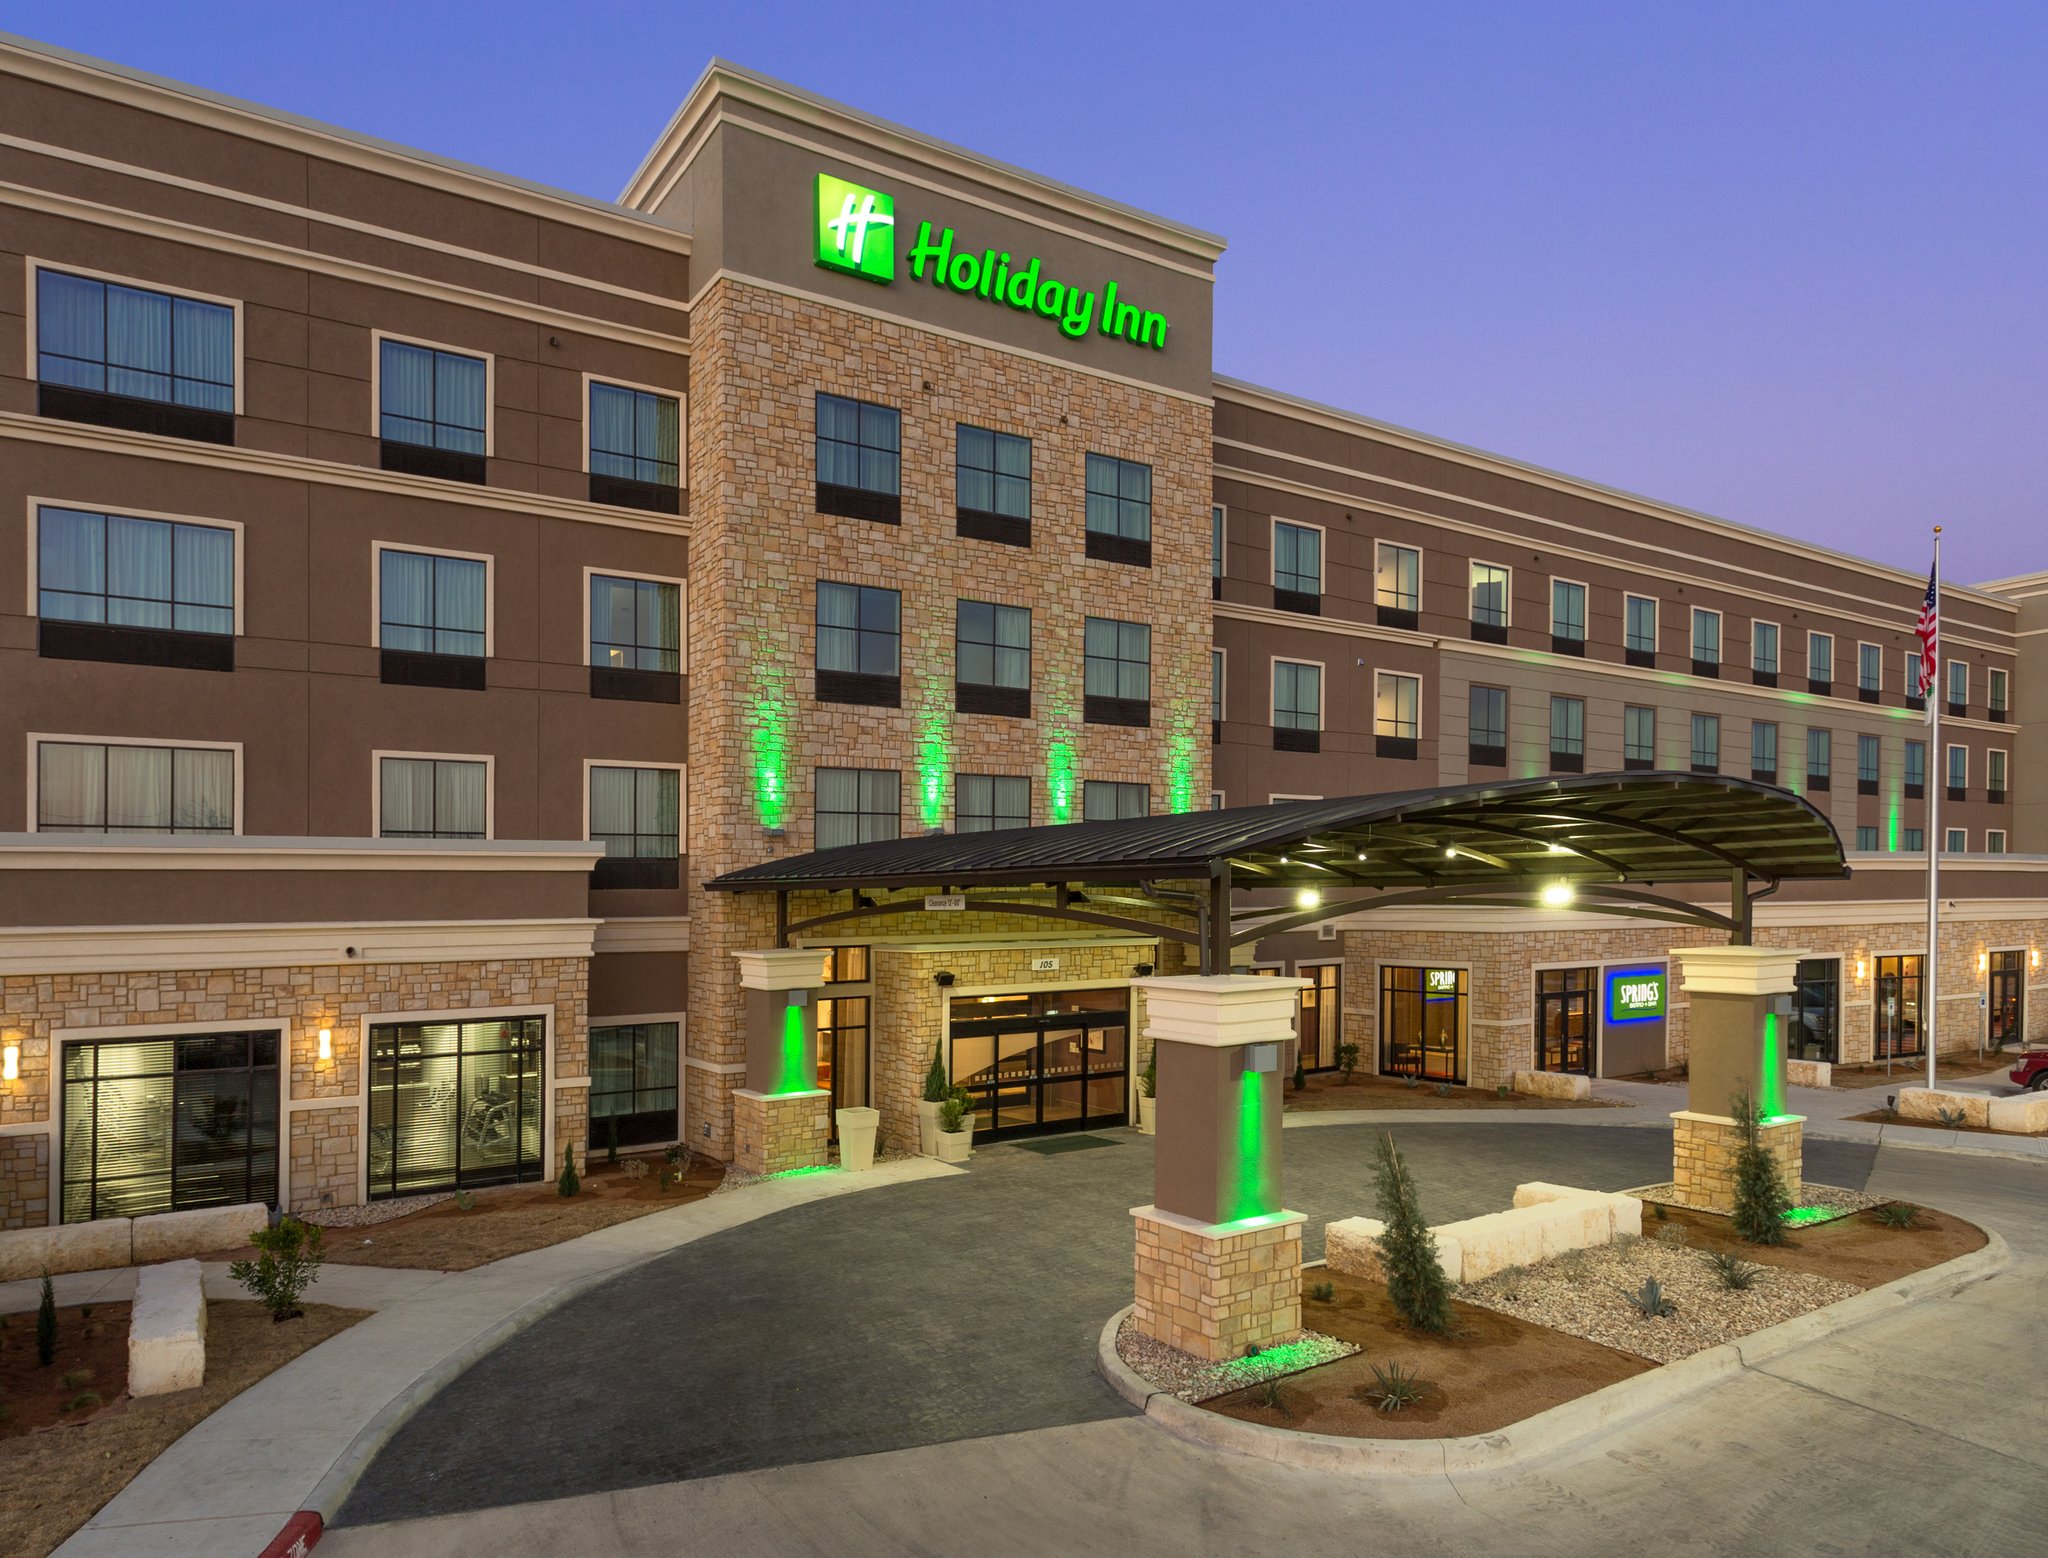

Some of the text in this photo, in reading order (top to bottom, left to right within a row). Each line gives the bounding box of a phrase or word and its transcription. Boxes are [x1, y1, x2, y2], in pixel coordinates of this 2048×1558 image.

[908, 220, 1168, 351] Holiday Inn
[929, 899, 947, 907] Clearance
[1039, 960, 1053, 969] 105
